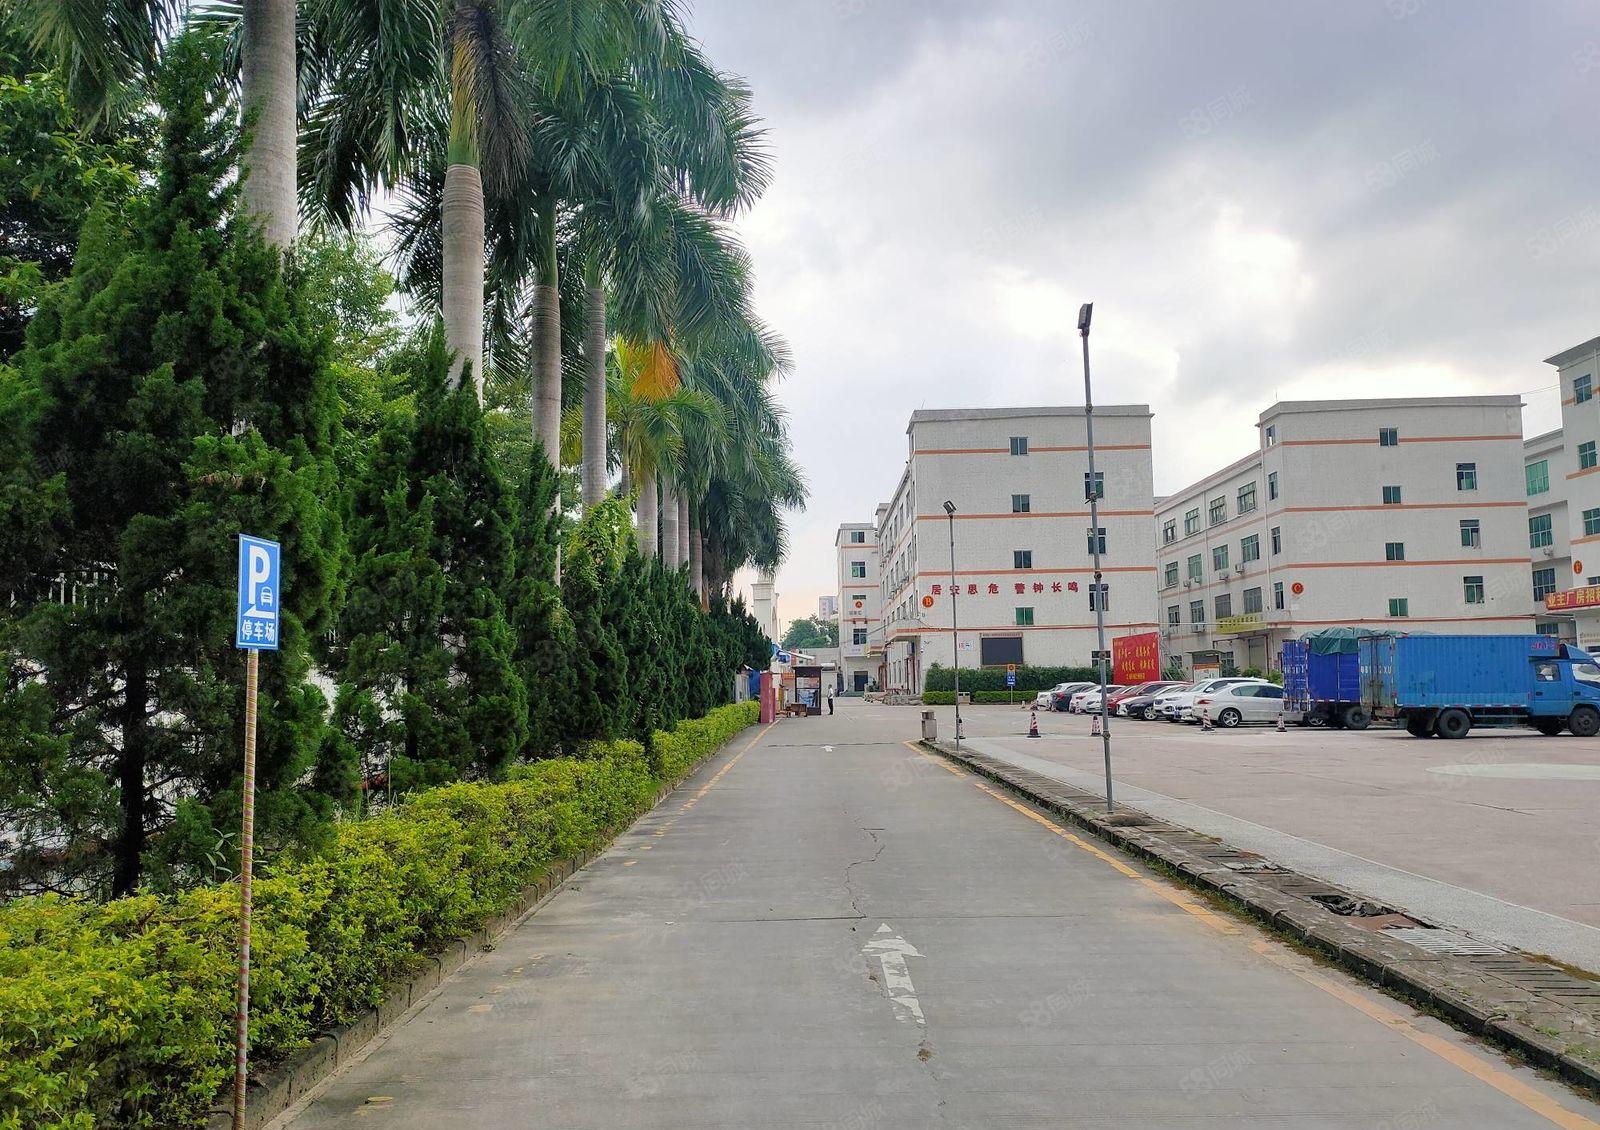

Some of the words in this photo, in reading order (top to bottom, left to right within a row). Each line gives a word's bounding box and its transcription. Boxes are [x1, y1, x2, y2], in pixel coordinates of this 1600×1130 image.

[248, 544, 271, 605] P
[241, 619, 275, 642] 停车场
